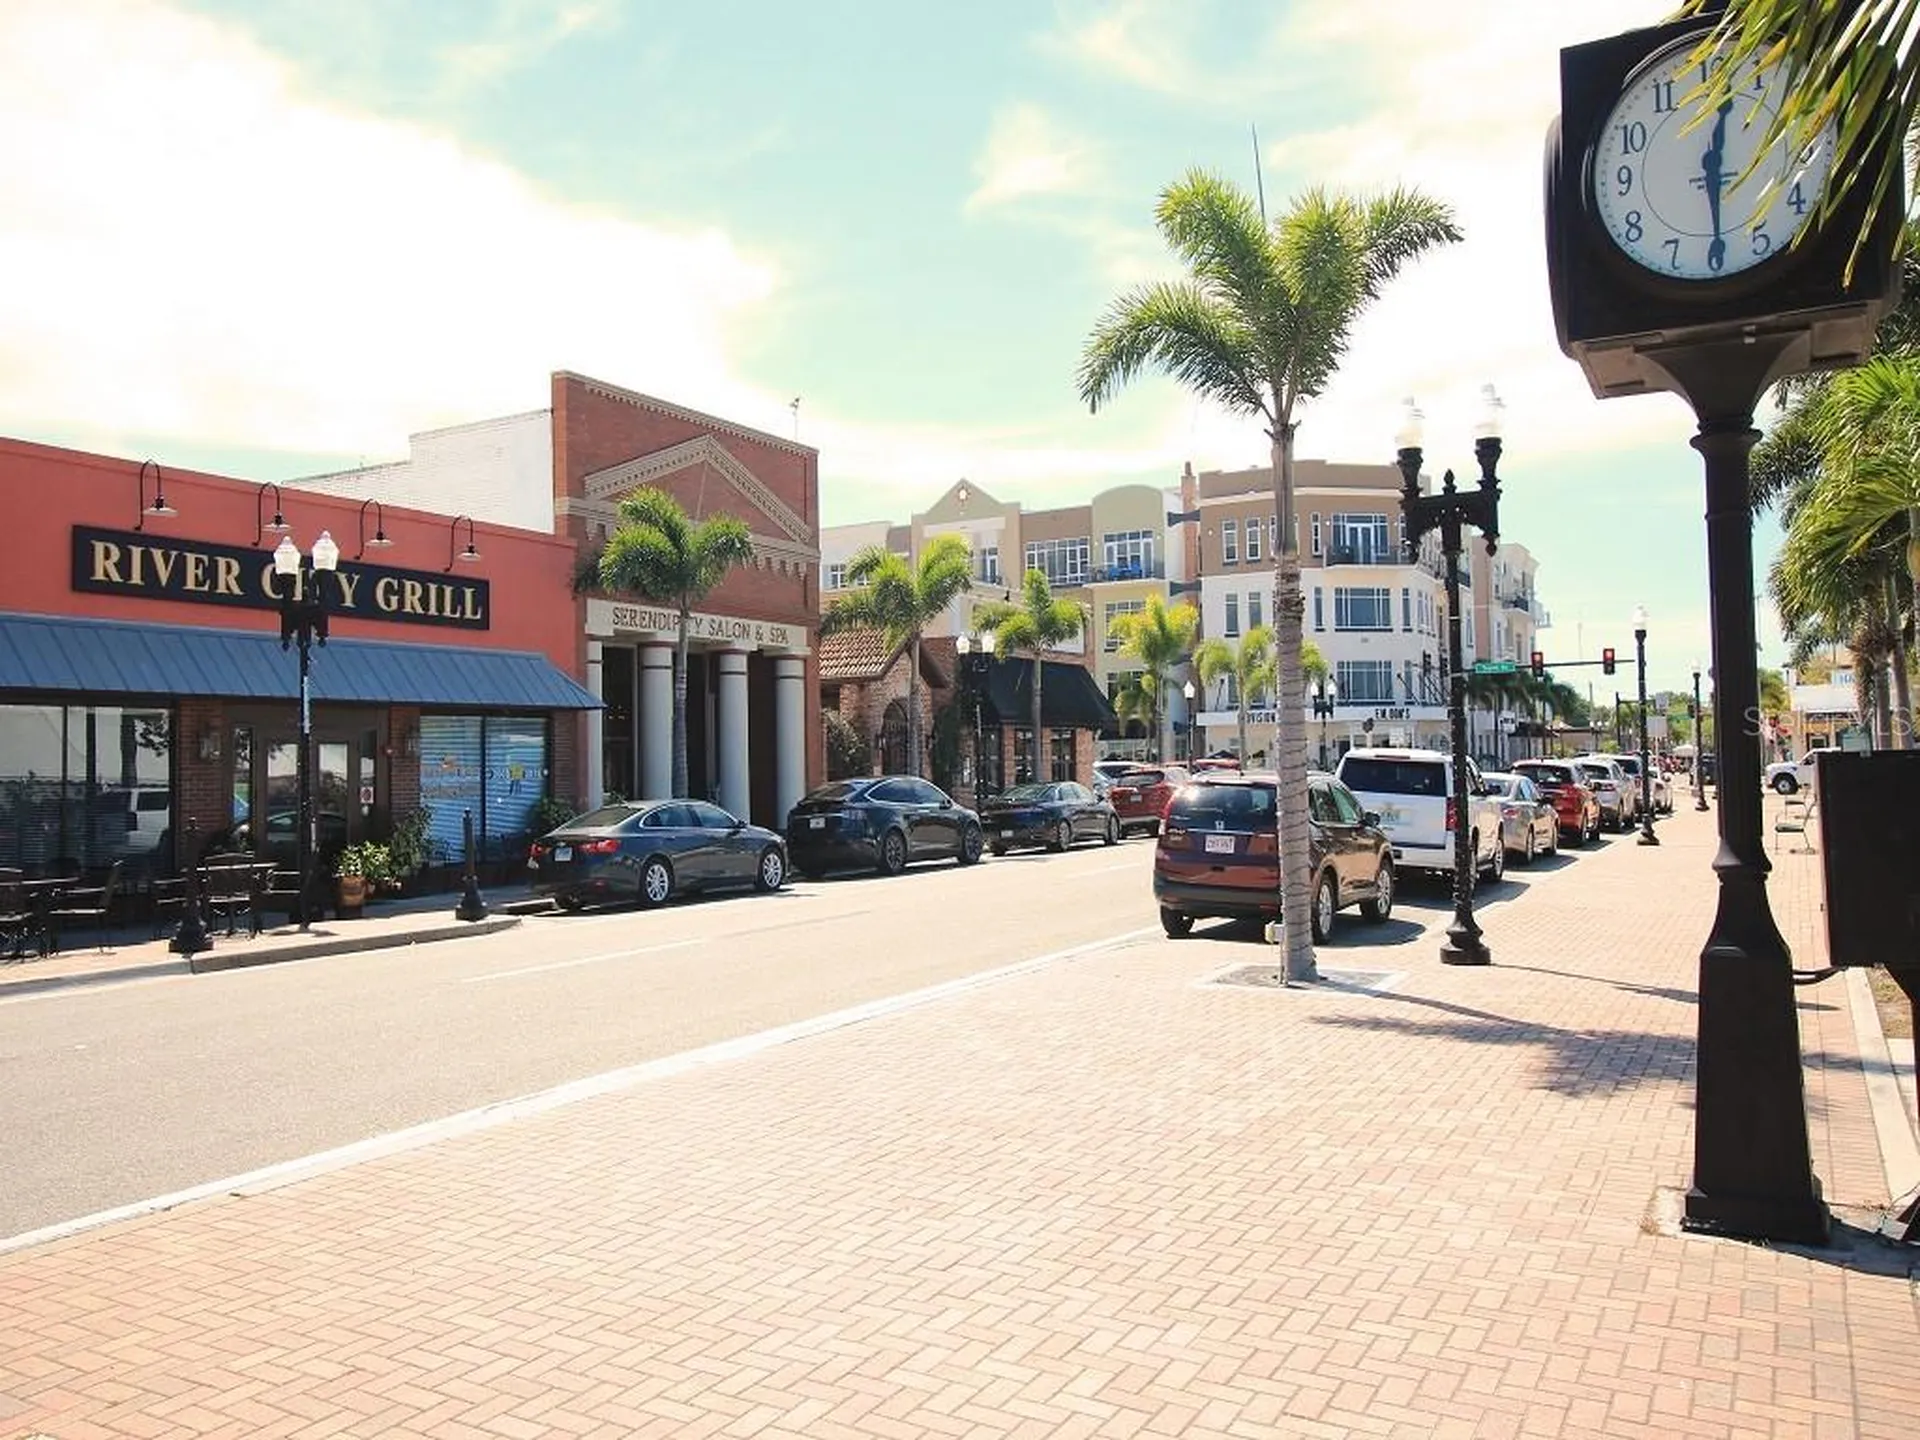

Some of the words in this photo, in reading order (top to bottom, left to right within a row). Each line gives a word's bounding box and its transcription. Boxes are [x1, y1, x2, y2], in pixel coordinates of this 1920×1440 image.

[1652, 80, 1676, 113] 11
[1620, 121, 1646, 154] 10
[1617, 165, 1632, 196] 9
[1786, 181, 1807, 216] 4
[1625, 210, 1643, 243] 8
[1752, 220, 1771, 255] 5
[1662, 238, 1681, 270] 7
[89, 539, 245, 596] RIVER
[261, 562, 361, 608] CIY
[375, 577, 482, 620] GRILL
[612, 606, 703, 635] SERENDIPTY
[708, 618, 750, 640] SALON
[755, 624, 764, 641] &
[769, 626, 789, 644] SPA
